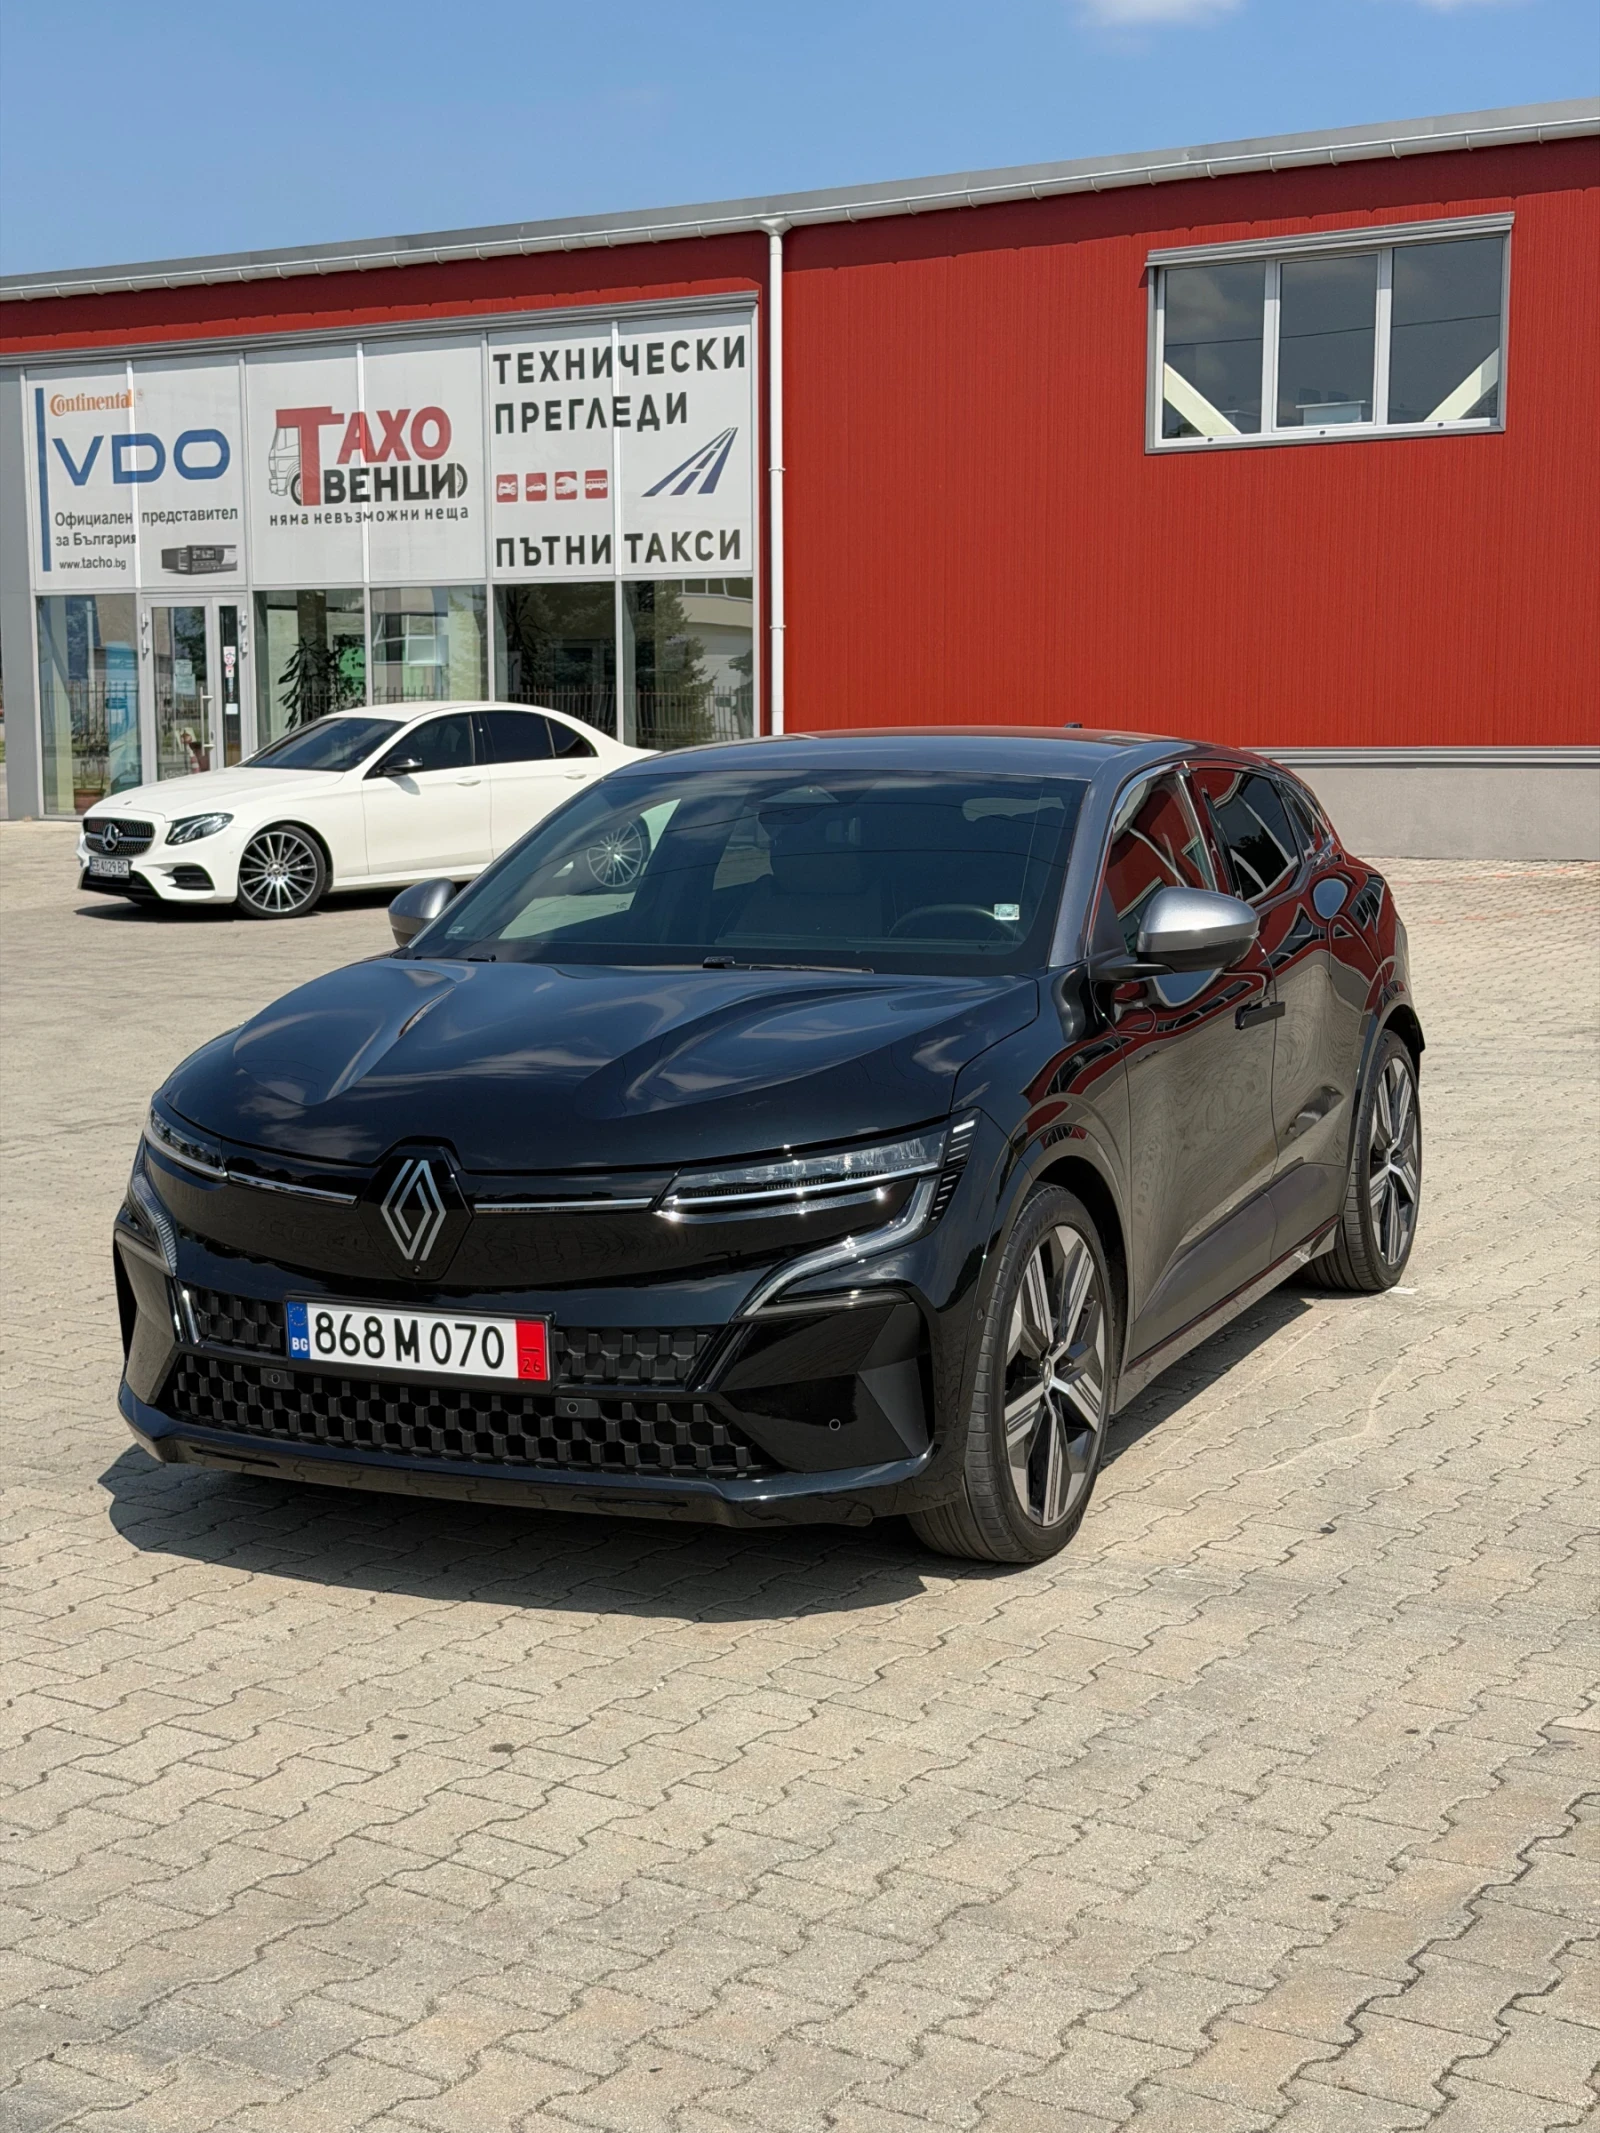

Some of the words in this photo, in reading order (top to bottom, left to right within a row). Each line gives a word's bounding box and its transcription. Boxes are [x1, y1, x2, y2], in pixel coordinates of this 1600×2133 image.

[493, 335, 745, 385] ТЕХНИЧЕСКИ
[50, 389, 133, 417] Continental
[495, 392, 687, 434] ПРЕГЛЕДИ
[52, 428, 231, 486] VDO
[276, 406, 452, 506] ТАХО
[323, 463, 456, 504] ВЕНЦИ
[55, 512, 133, 530] Официален
[141, 508, 238, 527] представител
[269, 513, 309, 526] няма
[314, 507, 419, 525] невъзможни
[424, 506, 469, 521] неща
[55, 535, 70, 547] за
[73, 532, 137, 550] България
[496, 534, 612, 567] ПЪТНИ
[623, 529, 741, 563] ТАКСИ
[59, 556, 127, 570] www.tacho.bg
[292, 1337, 308, 1351] BG
[315, 1312, 385, 1358] 868
[394, 1317, 420, 1363] M
[430, 1322, 504, 1369] 070
[522, 1358, 542, 1372] 26
